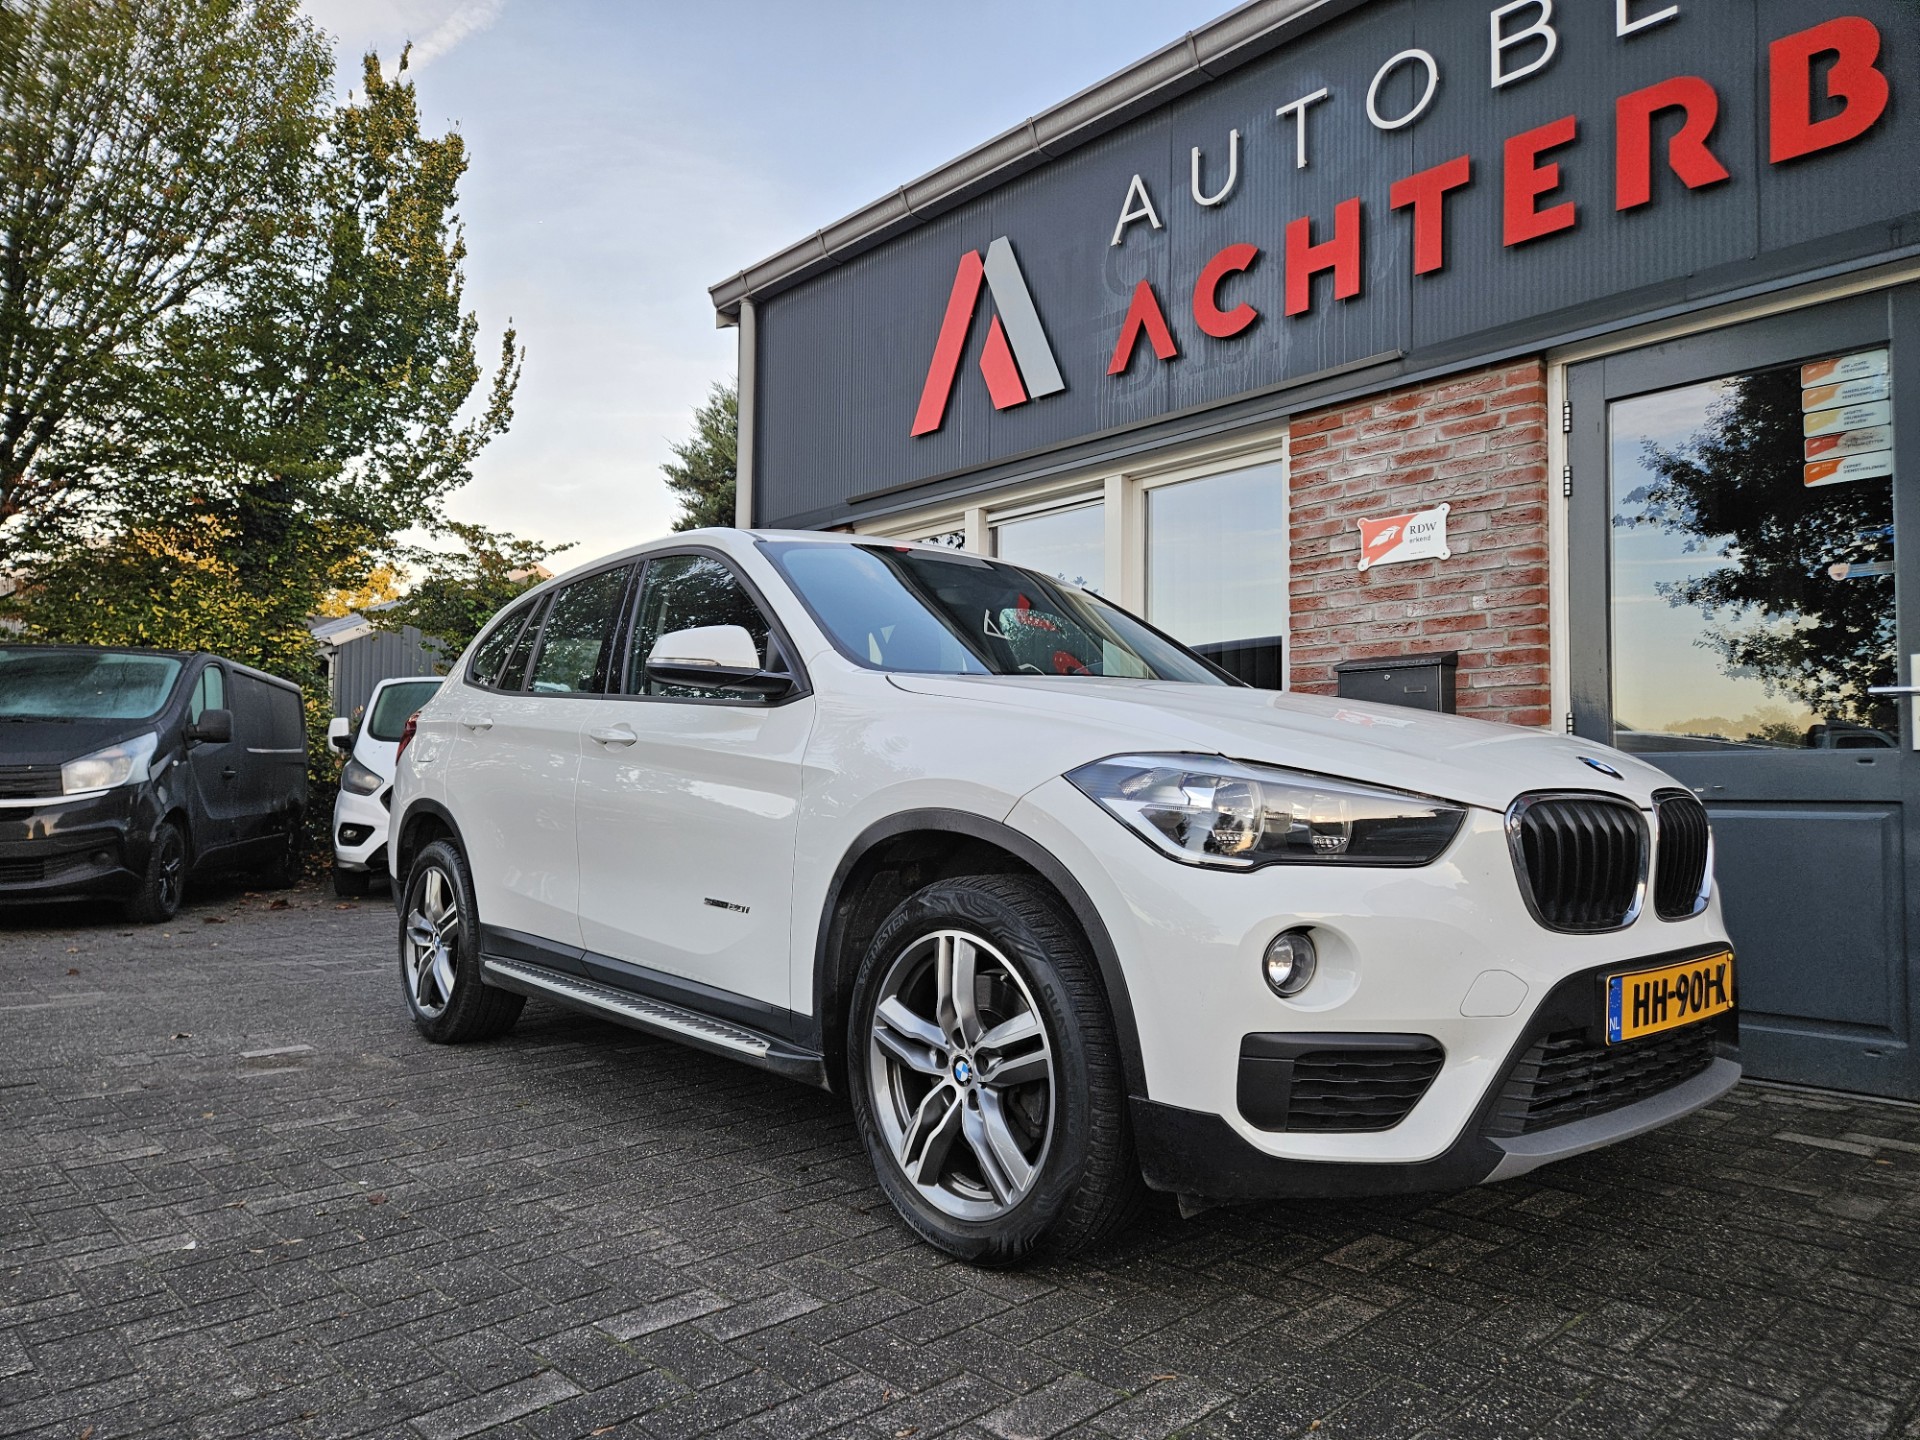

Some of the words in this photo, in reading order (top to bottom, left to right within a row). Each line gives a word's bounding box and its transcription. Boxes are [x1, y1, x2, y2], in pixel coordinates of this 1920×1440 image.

[1106, 15, 1889, 376] ACHTERB
[1409, 521, 1437, 535] RDW
[1409, 534, 1431, 544] erkend
[1632, 963, 1727, 1029] HH-901-K
[1609, 1016, 1621, 1032] NL
